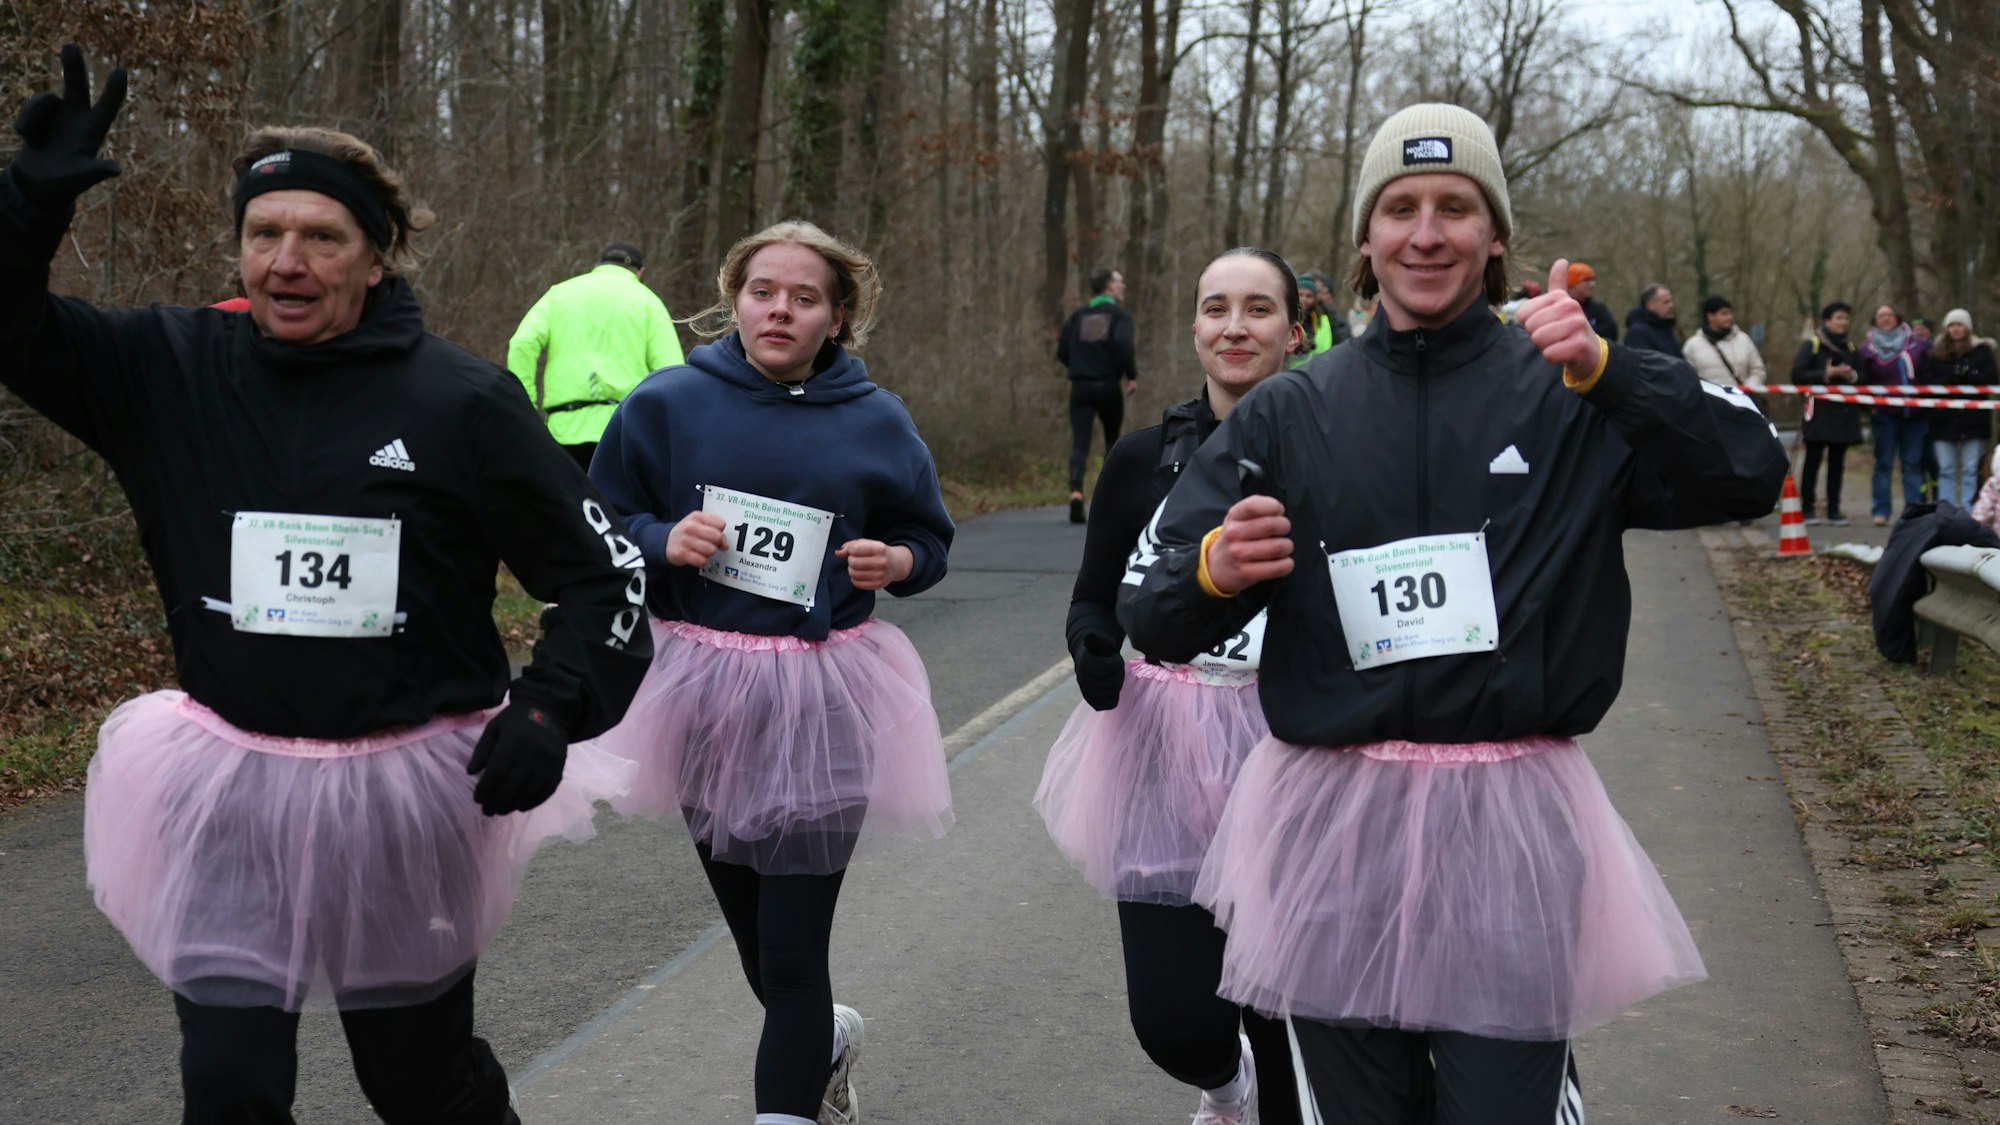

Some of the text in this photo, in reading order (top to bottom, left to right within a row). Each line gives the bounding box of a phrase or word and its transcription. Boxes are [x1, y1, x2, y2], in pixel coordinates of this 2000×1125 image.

[369, 455, 416, 472] adidas
[715, 493, 822, 524] 37. VR-Bank Bonn Rhein-Sieg
[743, 510, 791, 527] Silvesterlauf
[263, 519, 302, 530] VR-Bank
[305, 522, 330, 532] Bonn
[332, 523, 384, 537] Rhein-Sieg
[284, 534, 345, 547] Silvesterlauf
[734, 522, 795, 562] 129
[1340, 541, 1471, 568] 37. VR-Bank Bonn Rhein-Sieg
[275, 550, 352, 590] 134
[739, 557, 777, 572] Alexandra
[1375, 557, 1434, 574] Silvesterlauf
[285, 593, 336, 605] Christoph
[1371, 572, 1447, 617] 130
[1397, 616, 1424, 629] David
